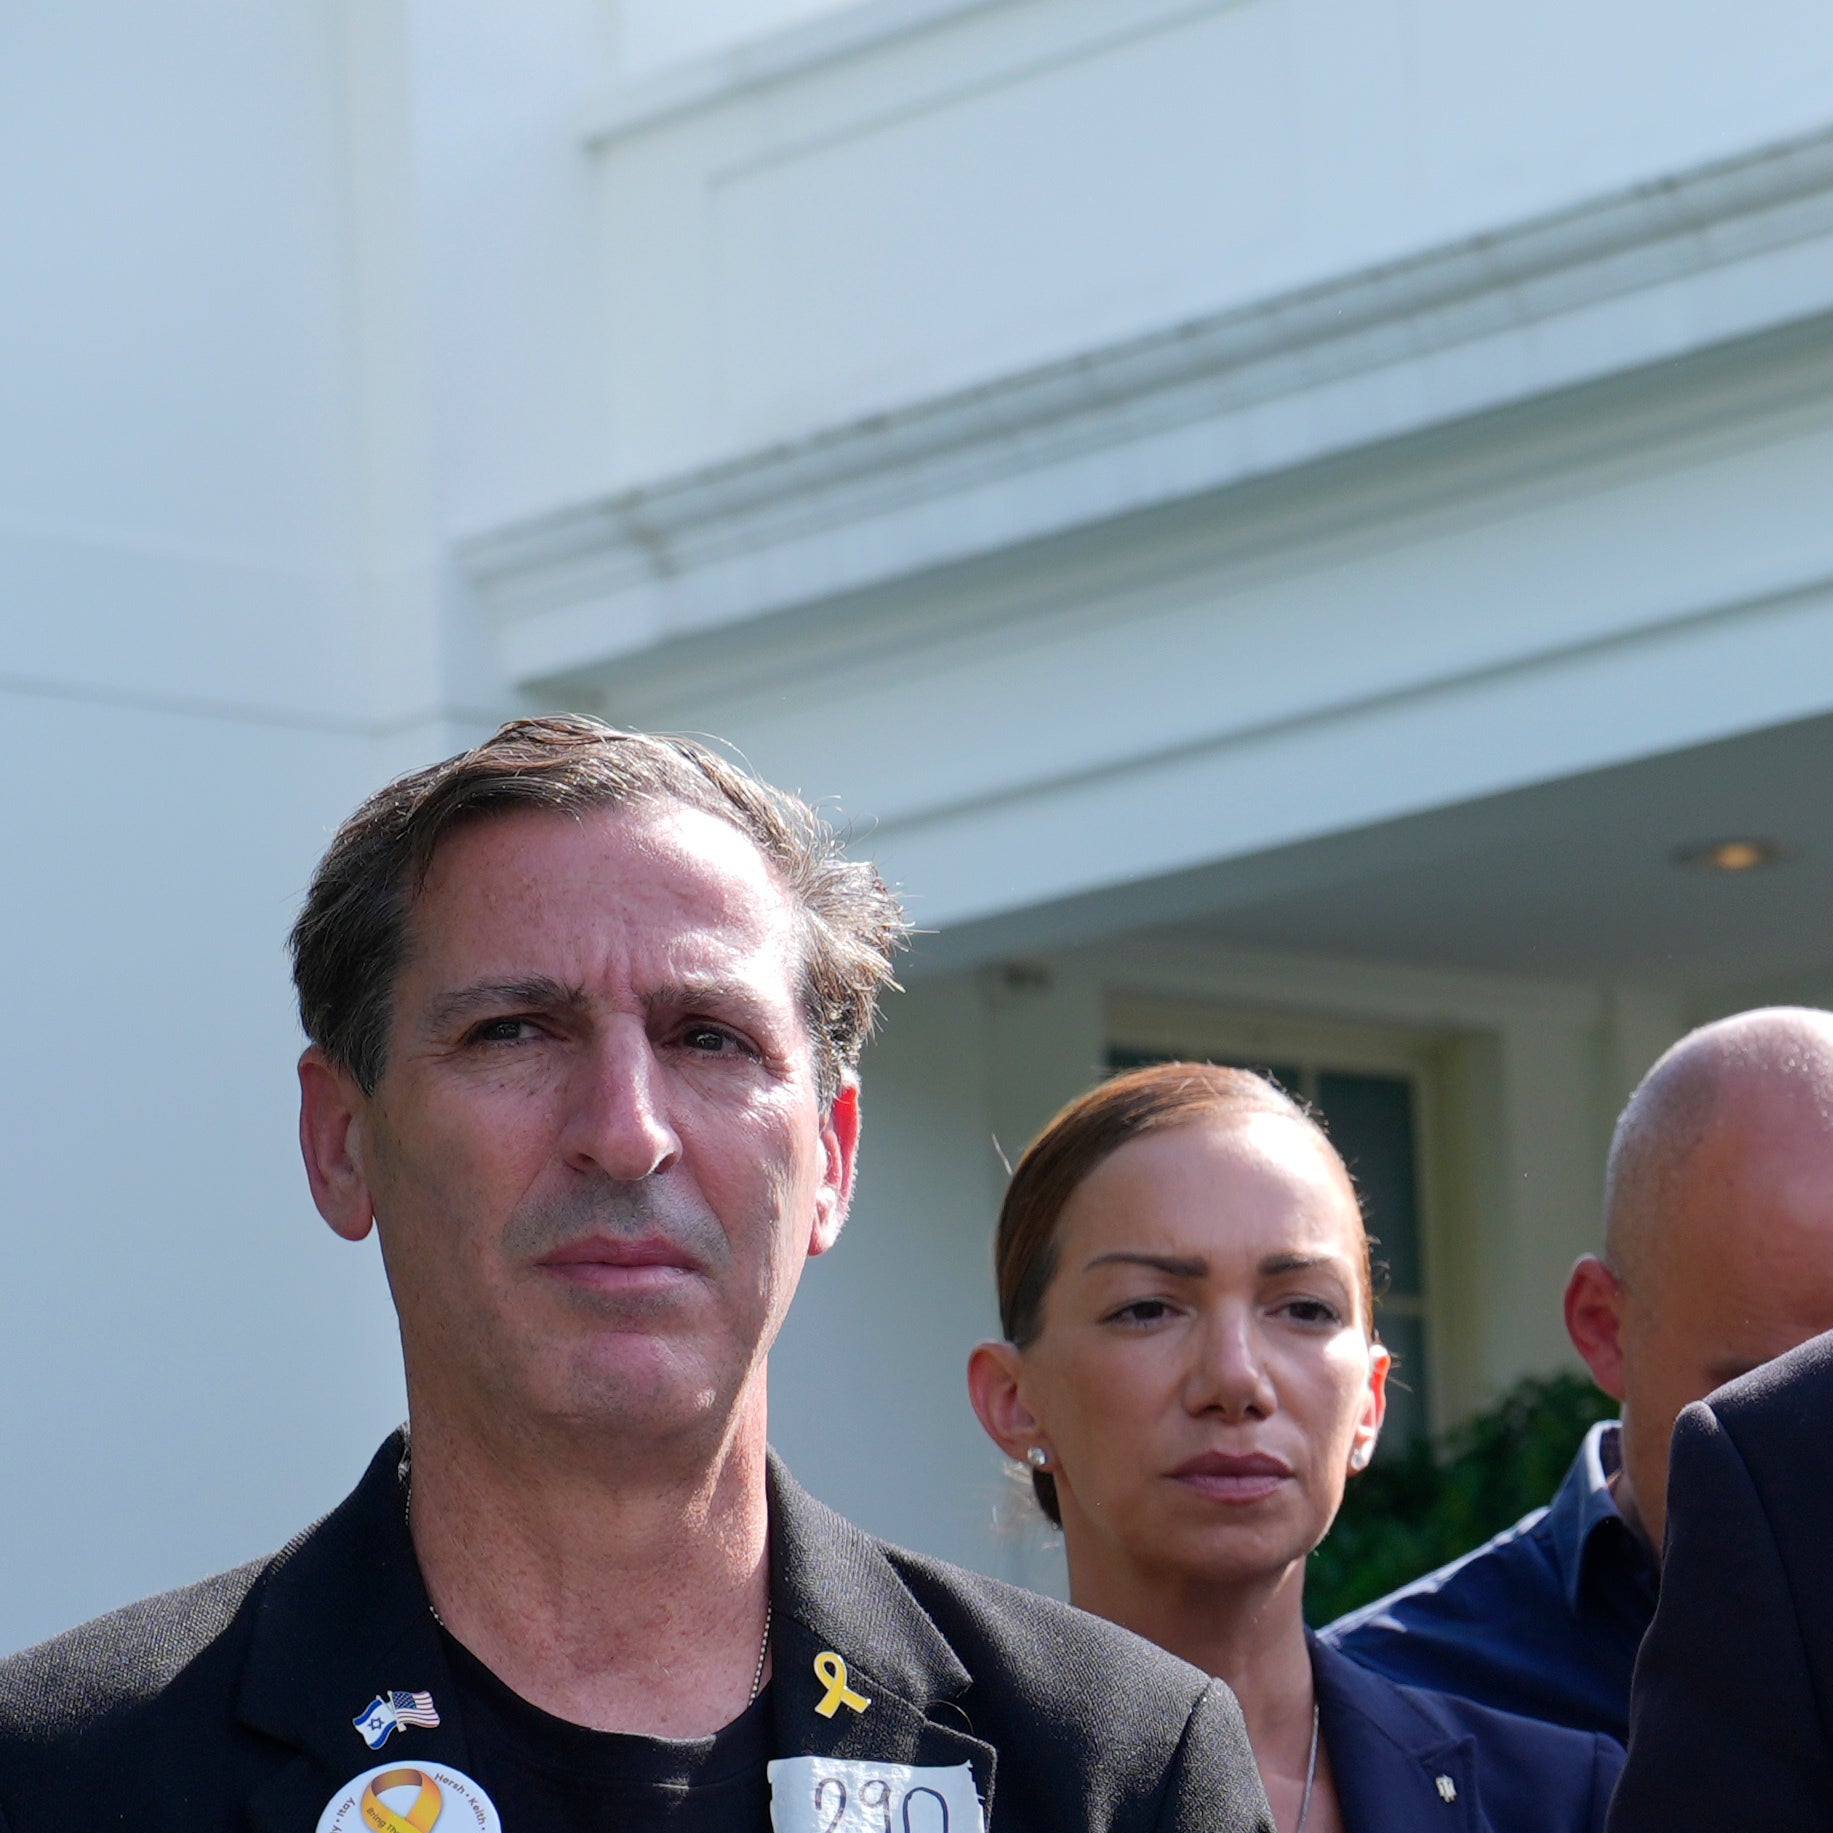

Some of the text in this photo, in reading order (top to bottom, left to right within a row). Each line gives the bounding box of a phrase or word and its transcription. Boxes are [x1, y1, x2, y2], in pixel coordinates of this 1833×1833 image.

[336, 1796, 356, 1818] Itay
[433, 1773, 465, 1794] Hersh
[468, 1797, 486, 1826] Keith
[366, 1807, 387, 1829] Bring
